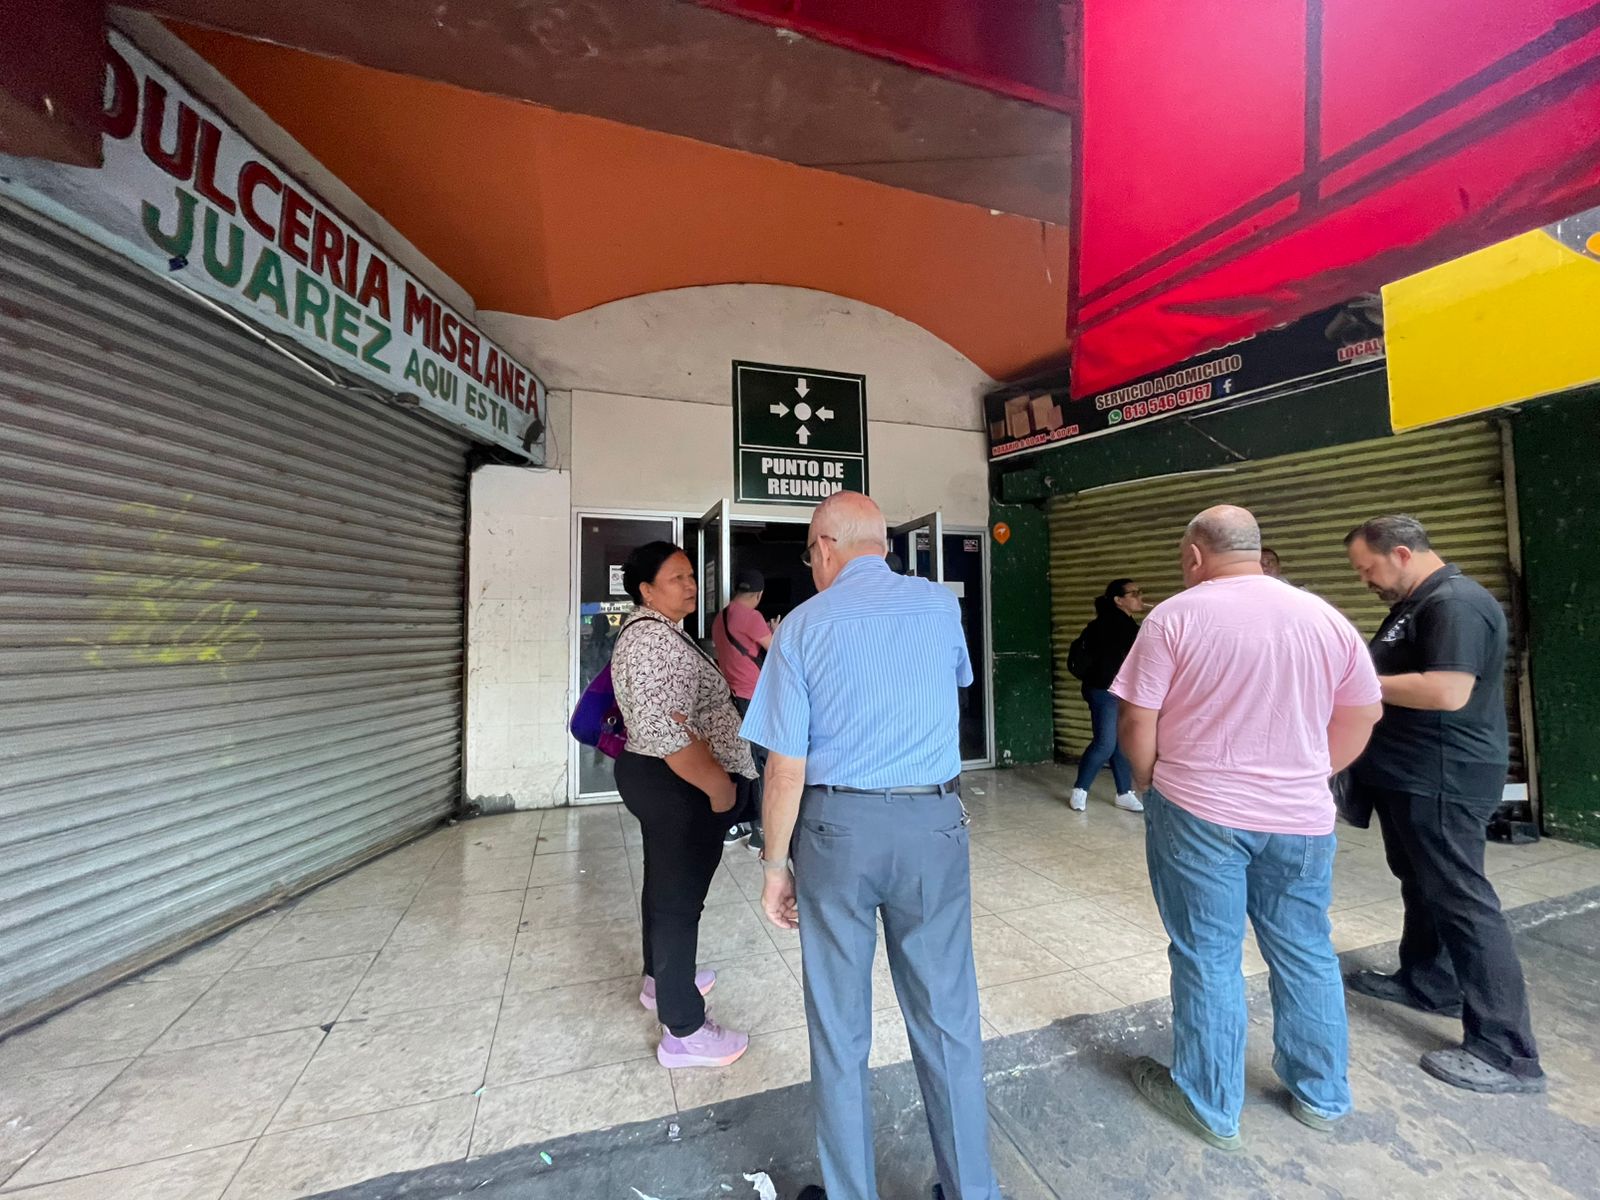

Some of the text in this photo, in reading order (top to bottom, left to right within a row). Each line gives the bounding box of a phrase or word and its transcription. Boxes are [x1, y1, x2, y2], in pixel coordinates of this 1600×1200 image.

[141, 186, 509, 435] JUAREZ AQUI ESTA
[403, 279, 540, 418] MISELANEA
[1337, 338, 1381, 362] LOCAL
[1095, 354, 1242, 410] SERVICIO A DOMICILIO
[1122, 401, 1148, 422] 813
[1148, 392, 1176, 413] 546
[1176, 383, 1212, 408] 9767
[761, 457, 844, 478] PUNTO DE
